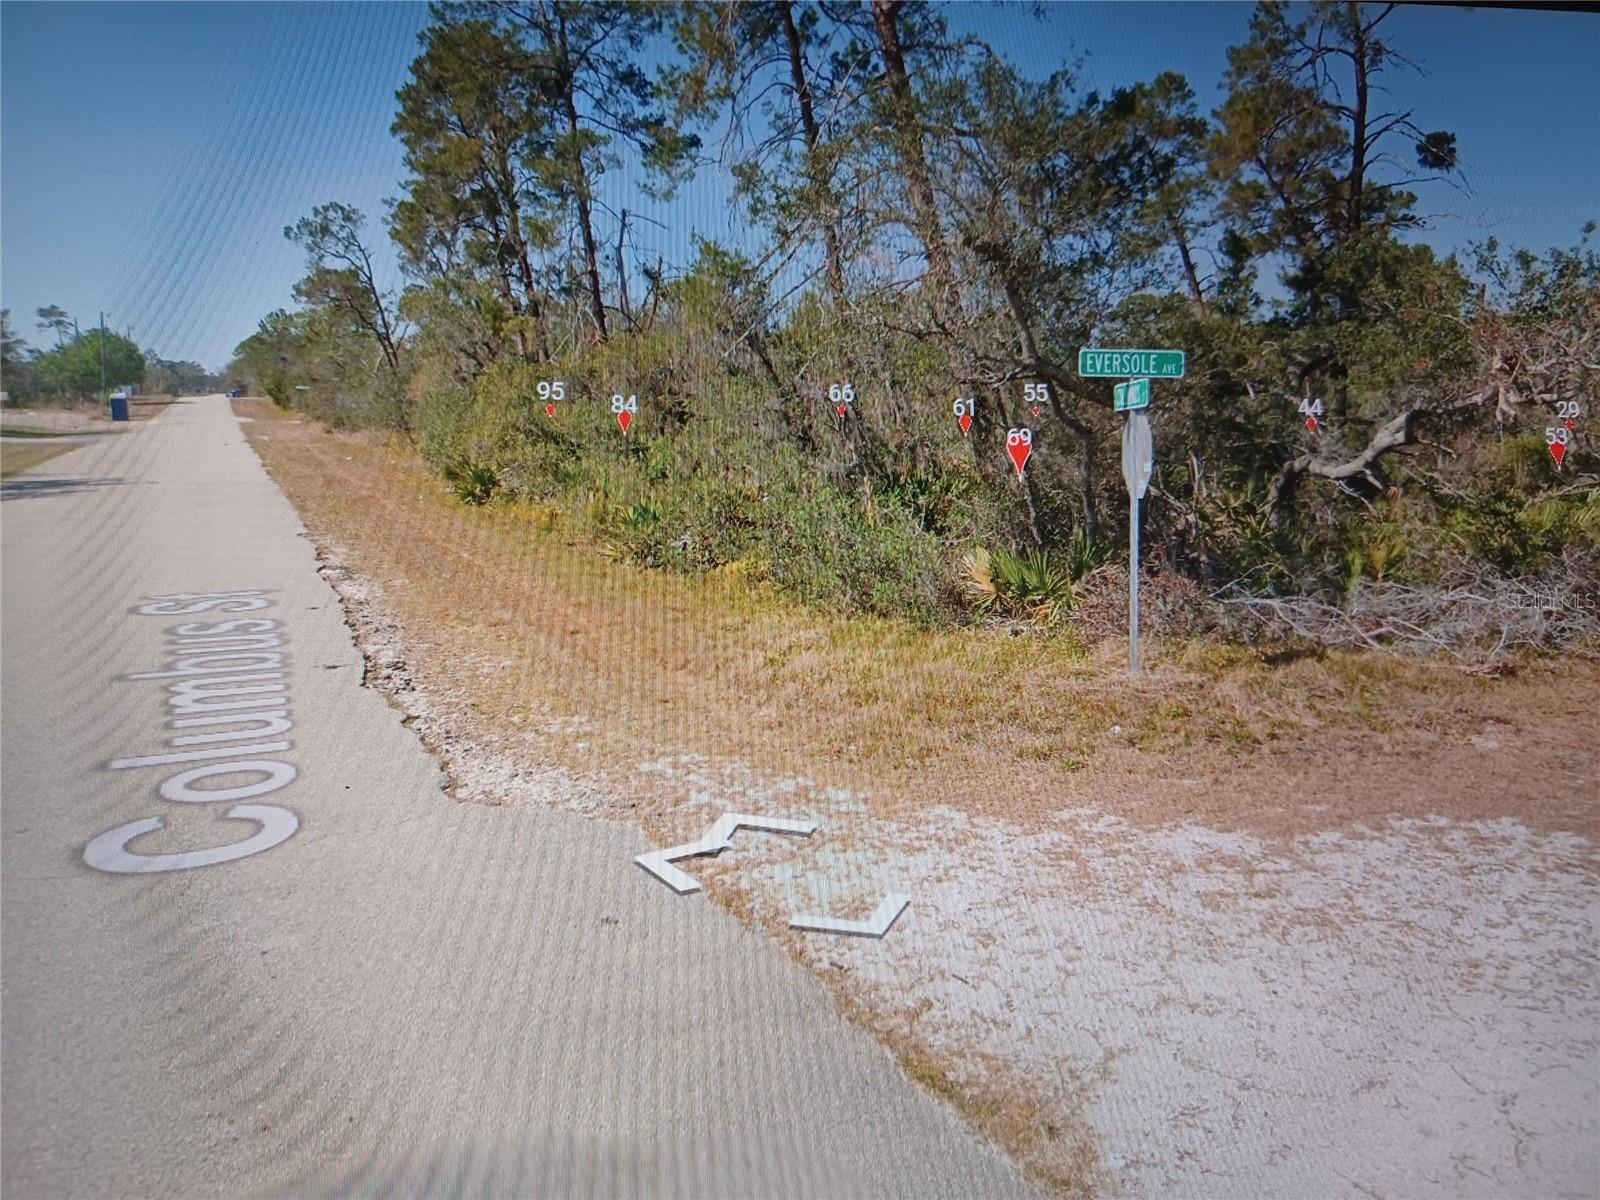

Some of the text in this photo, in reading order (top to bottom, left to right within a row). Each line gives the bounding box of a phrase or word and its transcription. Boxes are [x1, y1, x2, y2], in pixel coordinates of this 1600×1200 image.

[1086, 353, 1176, 375] EVERSOLE AVE
[537, 382, 565, 400] 95
[829, 384, 855, 402] 66
[1024, 383, 1049, 402] 55
[611, 395, 637, 413] 84
[953, 398, 975, 416] 61
[1298, 399, 1322, 416] 44
[1556, 401, 1580, 418] 29
[1007, 428, 1032, 446] 69
[1545, 428, 1568, 444] 53
[83, 619, 299, 874] Columbus
